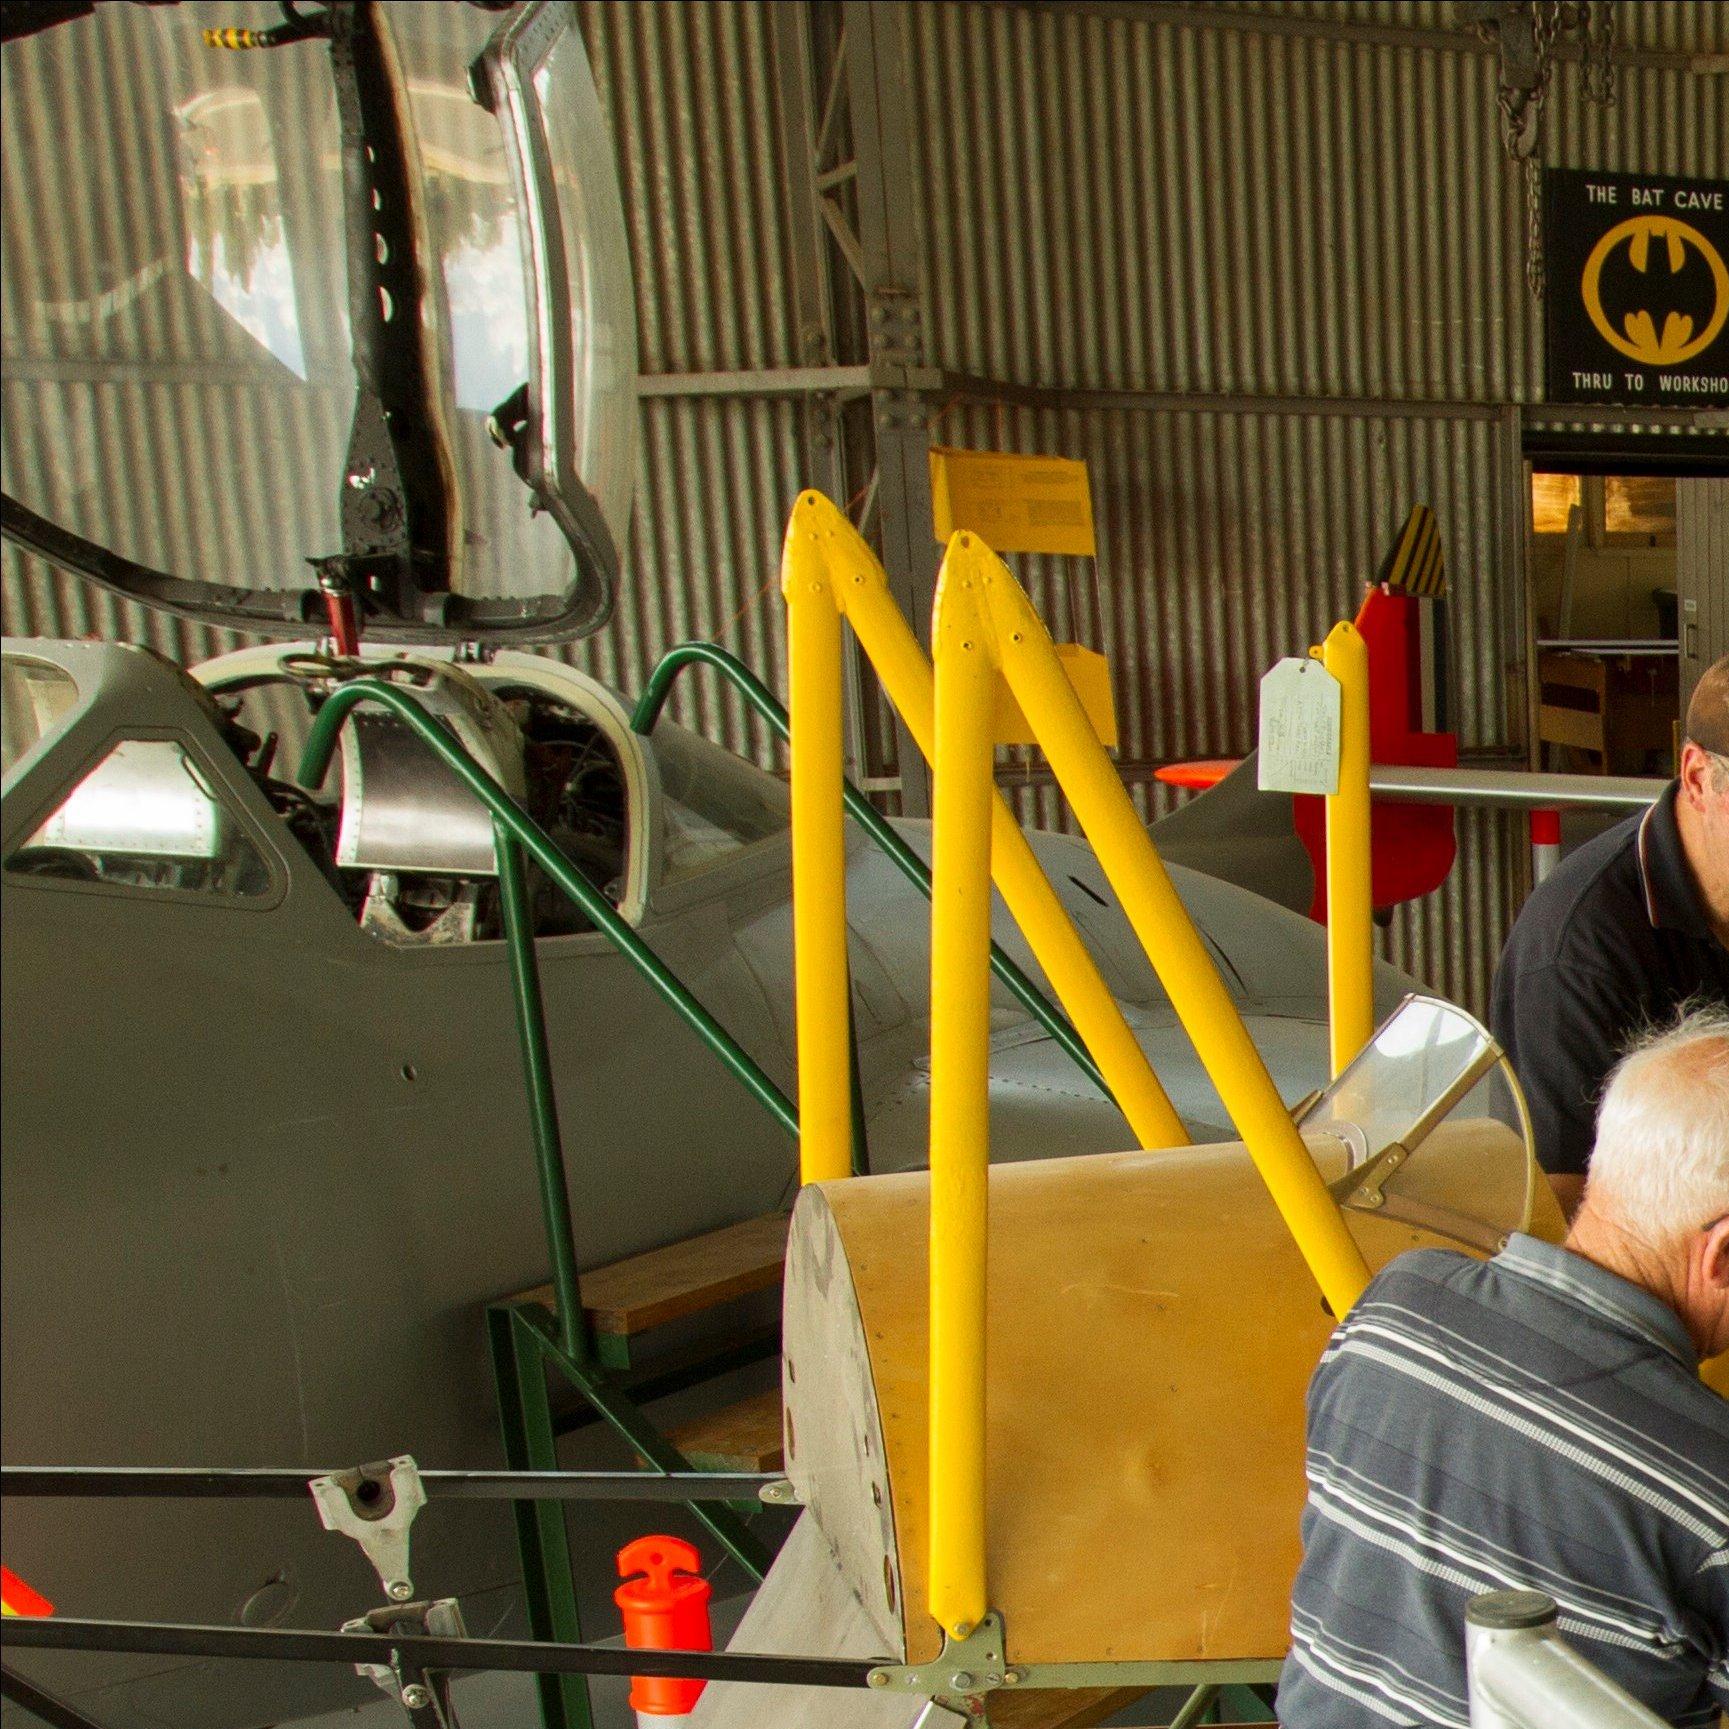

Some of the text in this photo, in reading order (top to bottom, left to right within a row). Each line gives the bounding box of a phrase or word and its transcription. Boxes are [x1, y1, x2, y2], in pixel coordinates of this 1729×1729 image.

[1586, 184, 1723, 211] THE BAT CAVE
[1572, 372, 1612, 390] THRU
[1625, 374, 1643, 390] TO
